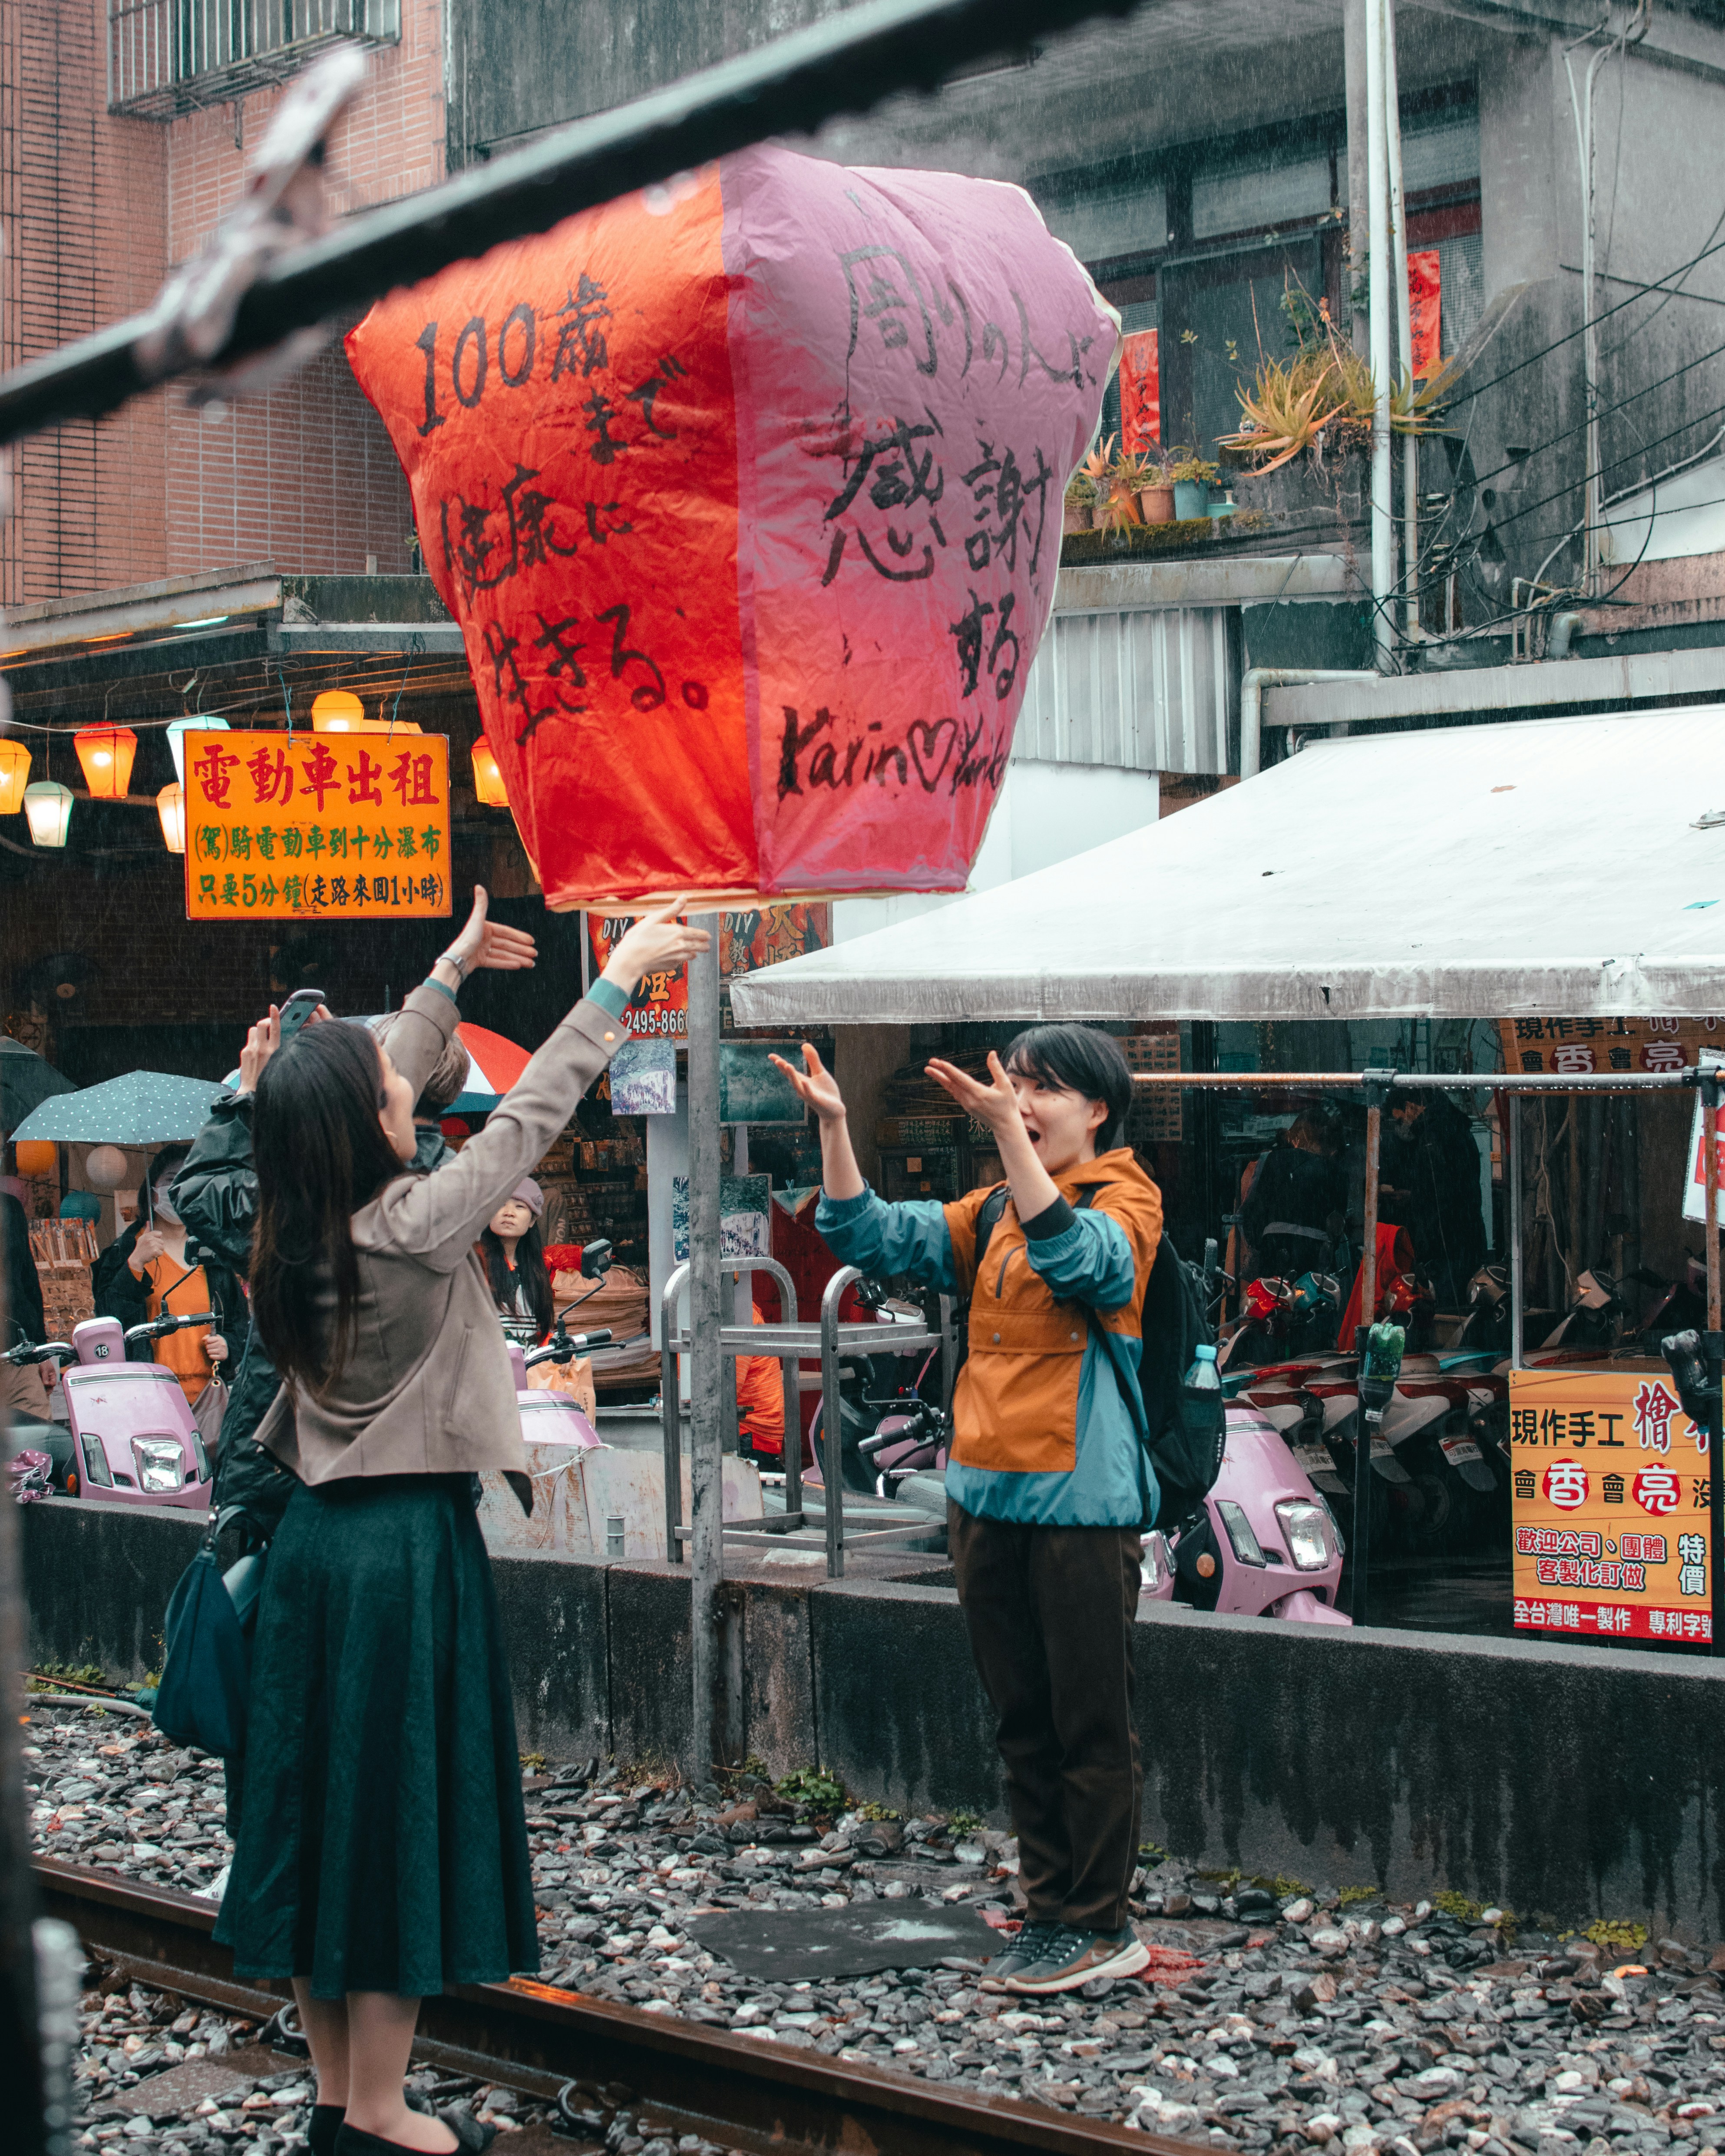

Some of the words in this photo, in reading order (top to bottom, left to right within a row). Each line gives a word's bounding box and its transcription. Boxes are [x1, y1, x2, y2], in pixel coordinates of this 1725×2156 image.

[581, 354, 688, 465] まで
[822, 410, 1052, 587] 感謝
[440, 463, 633, 606] 健康に
[948, 589, 1019, 700] する
[194, 742, 440, 812] 電動車出租
[602, 918, 628, 939] DIY
[724, 913, 753, 933] DIY
[96, 1346, 109, 1356] 18
[1511, 1409, 1624, 1447] 現作手工
[1538, 1558, 1644, 1589] 客製化訂做
[1679, 1534, 1705, 1595] 特價
[1514, 1601, 1631, 1631] 全台灣唯一製作
